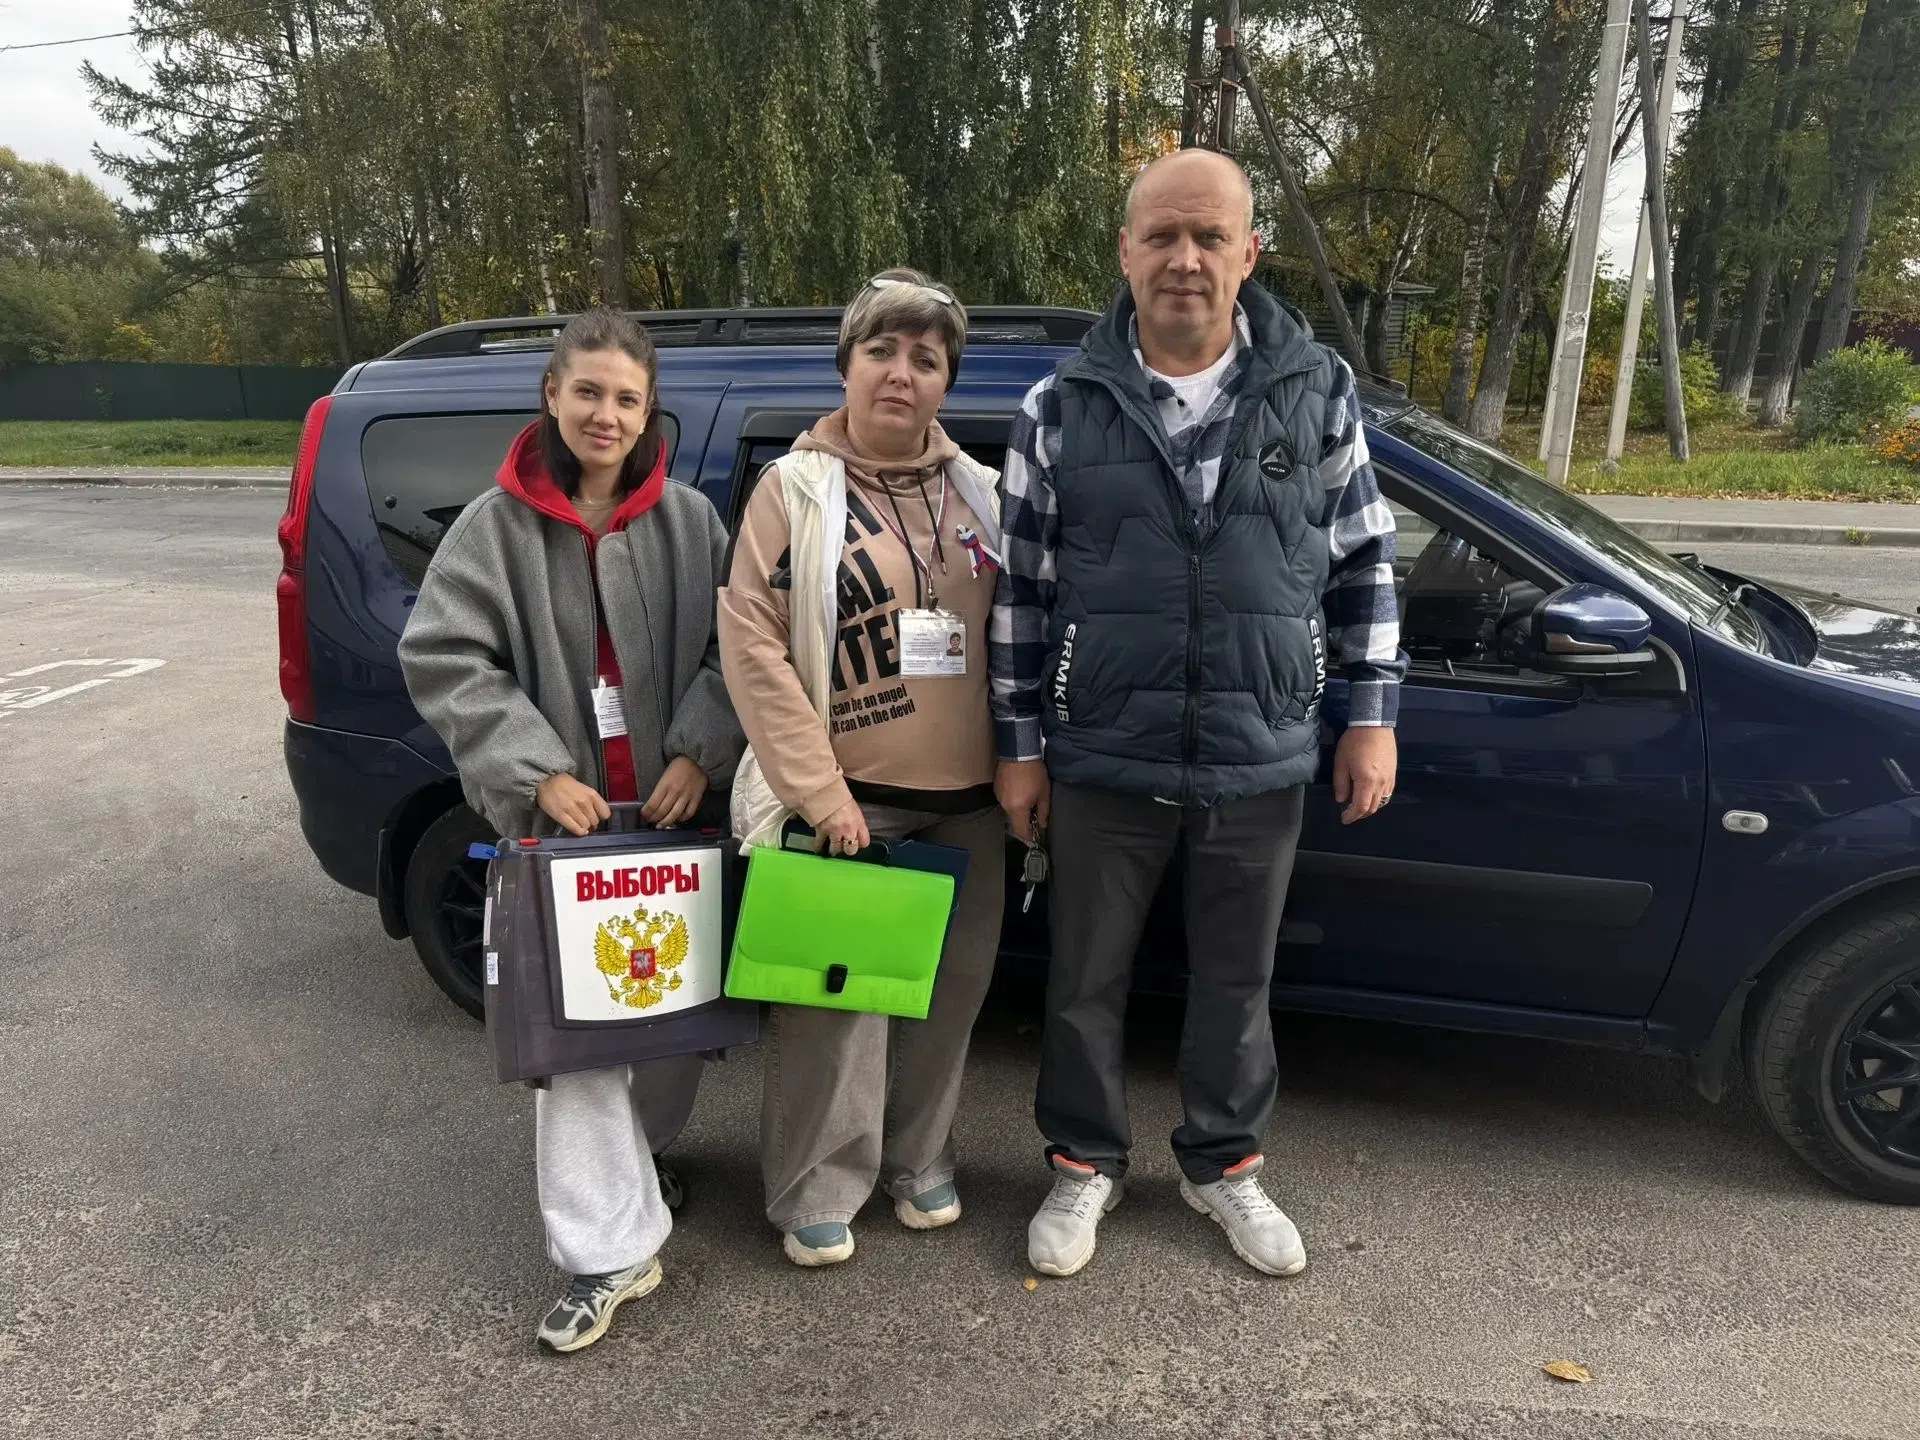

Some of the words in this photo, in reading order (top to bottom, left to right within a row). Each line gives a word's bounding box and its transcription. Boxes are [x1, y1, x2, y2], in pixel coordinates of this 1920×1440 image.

[832, 700, 851, 717] can
[851, 697, 863, 713] be
[863, 694, 878, 710] an
[877, 683, 908, 705] angel
[840, 717, 857, 733] can
[856, 714, 872, 729] be
[871, 709, 890, 725] the
[889, 698, 916, 720] devil
[576, 863, 700, 902] ВЫБОРЫ
